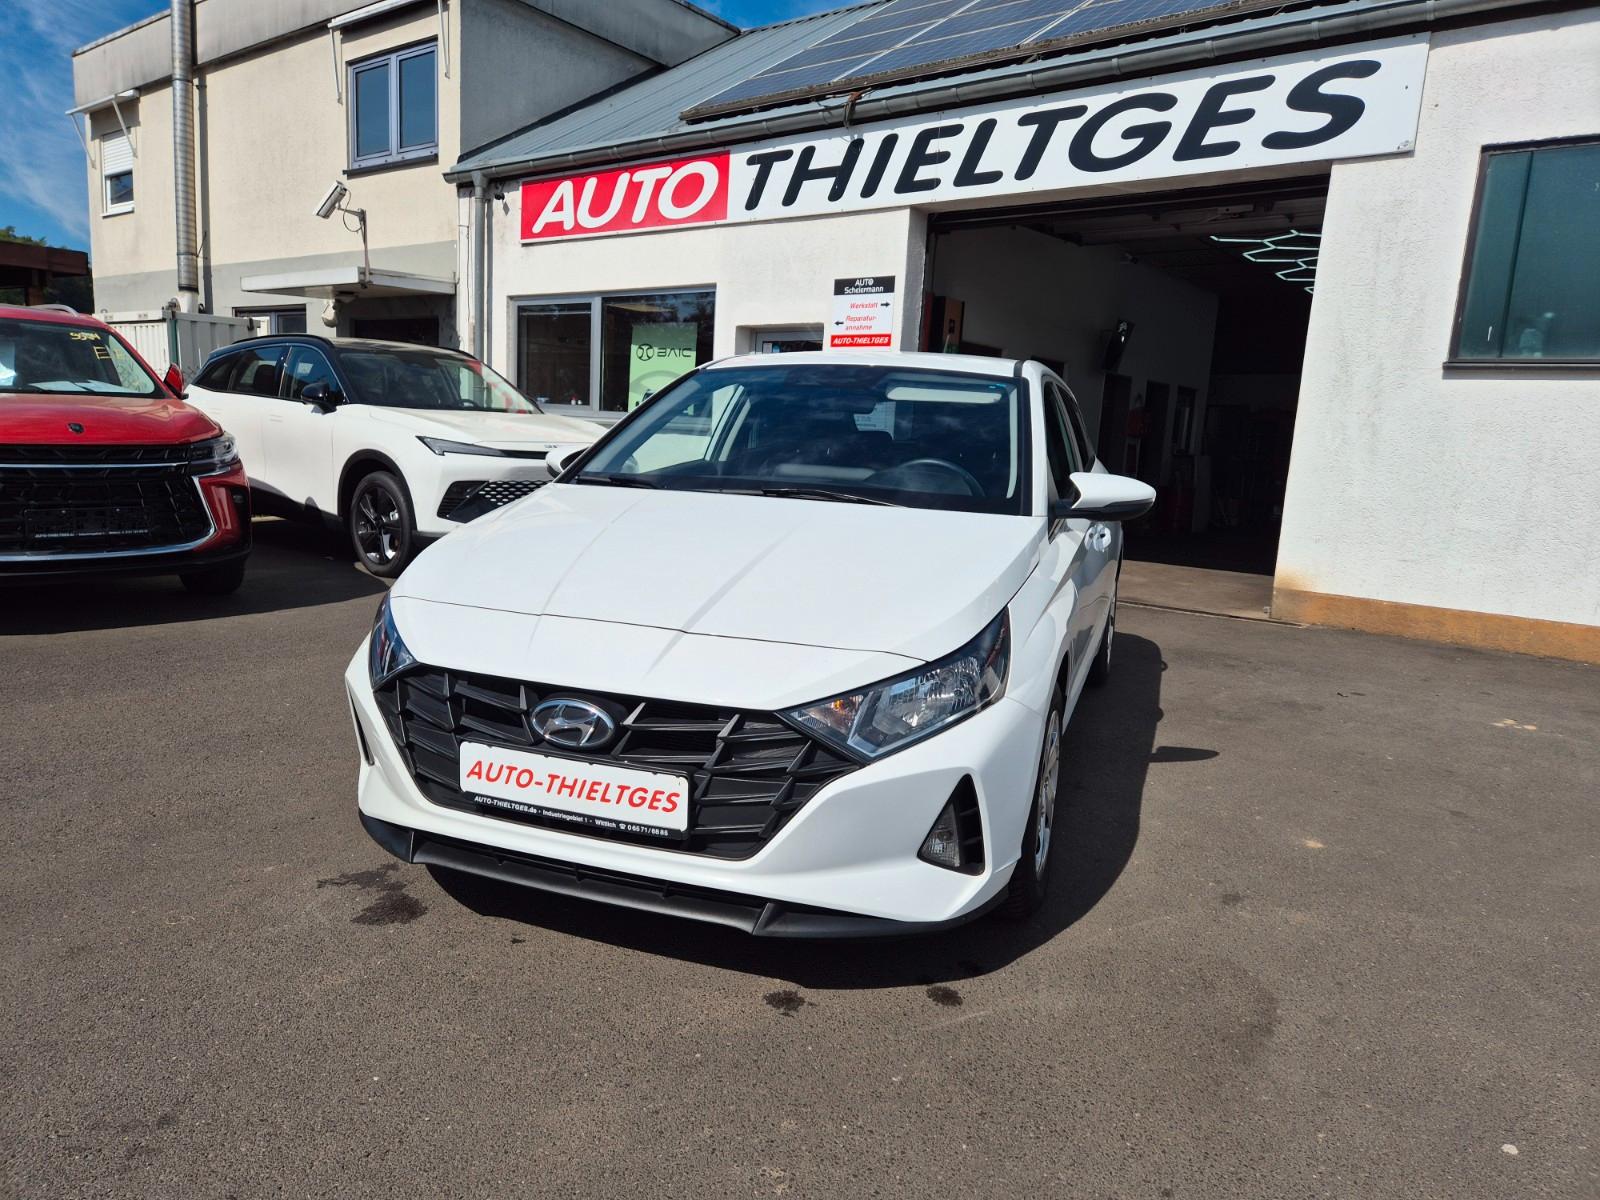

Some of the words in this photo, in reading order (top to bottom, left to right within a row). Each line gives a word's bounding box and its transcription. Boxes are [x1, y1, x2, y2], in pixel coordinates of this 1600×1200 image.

[532, 161, 719, 234] AUTO
[746, 60, 1382, 211] THIELTGES
[855, 278, 874, 286] AUTO
[833, 336, 889, 344] AUTO-THIELTGES
[657, 347, 692, 358] BAIC
[466, 760, 681, 813] AUTO-THIELTGES
[474, 795, 538, 814] AUTO-THIELTGES.de
